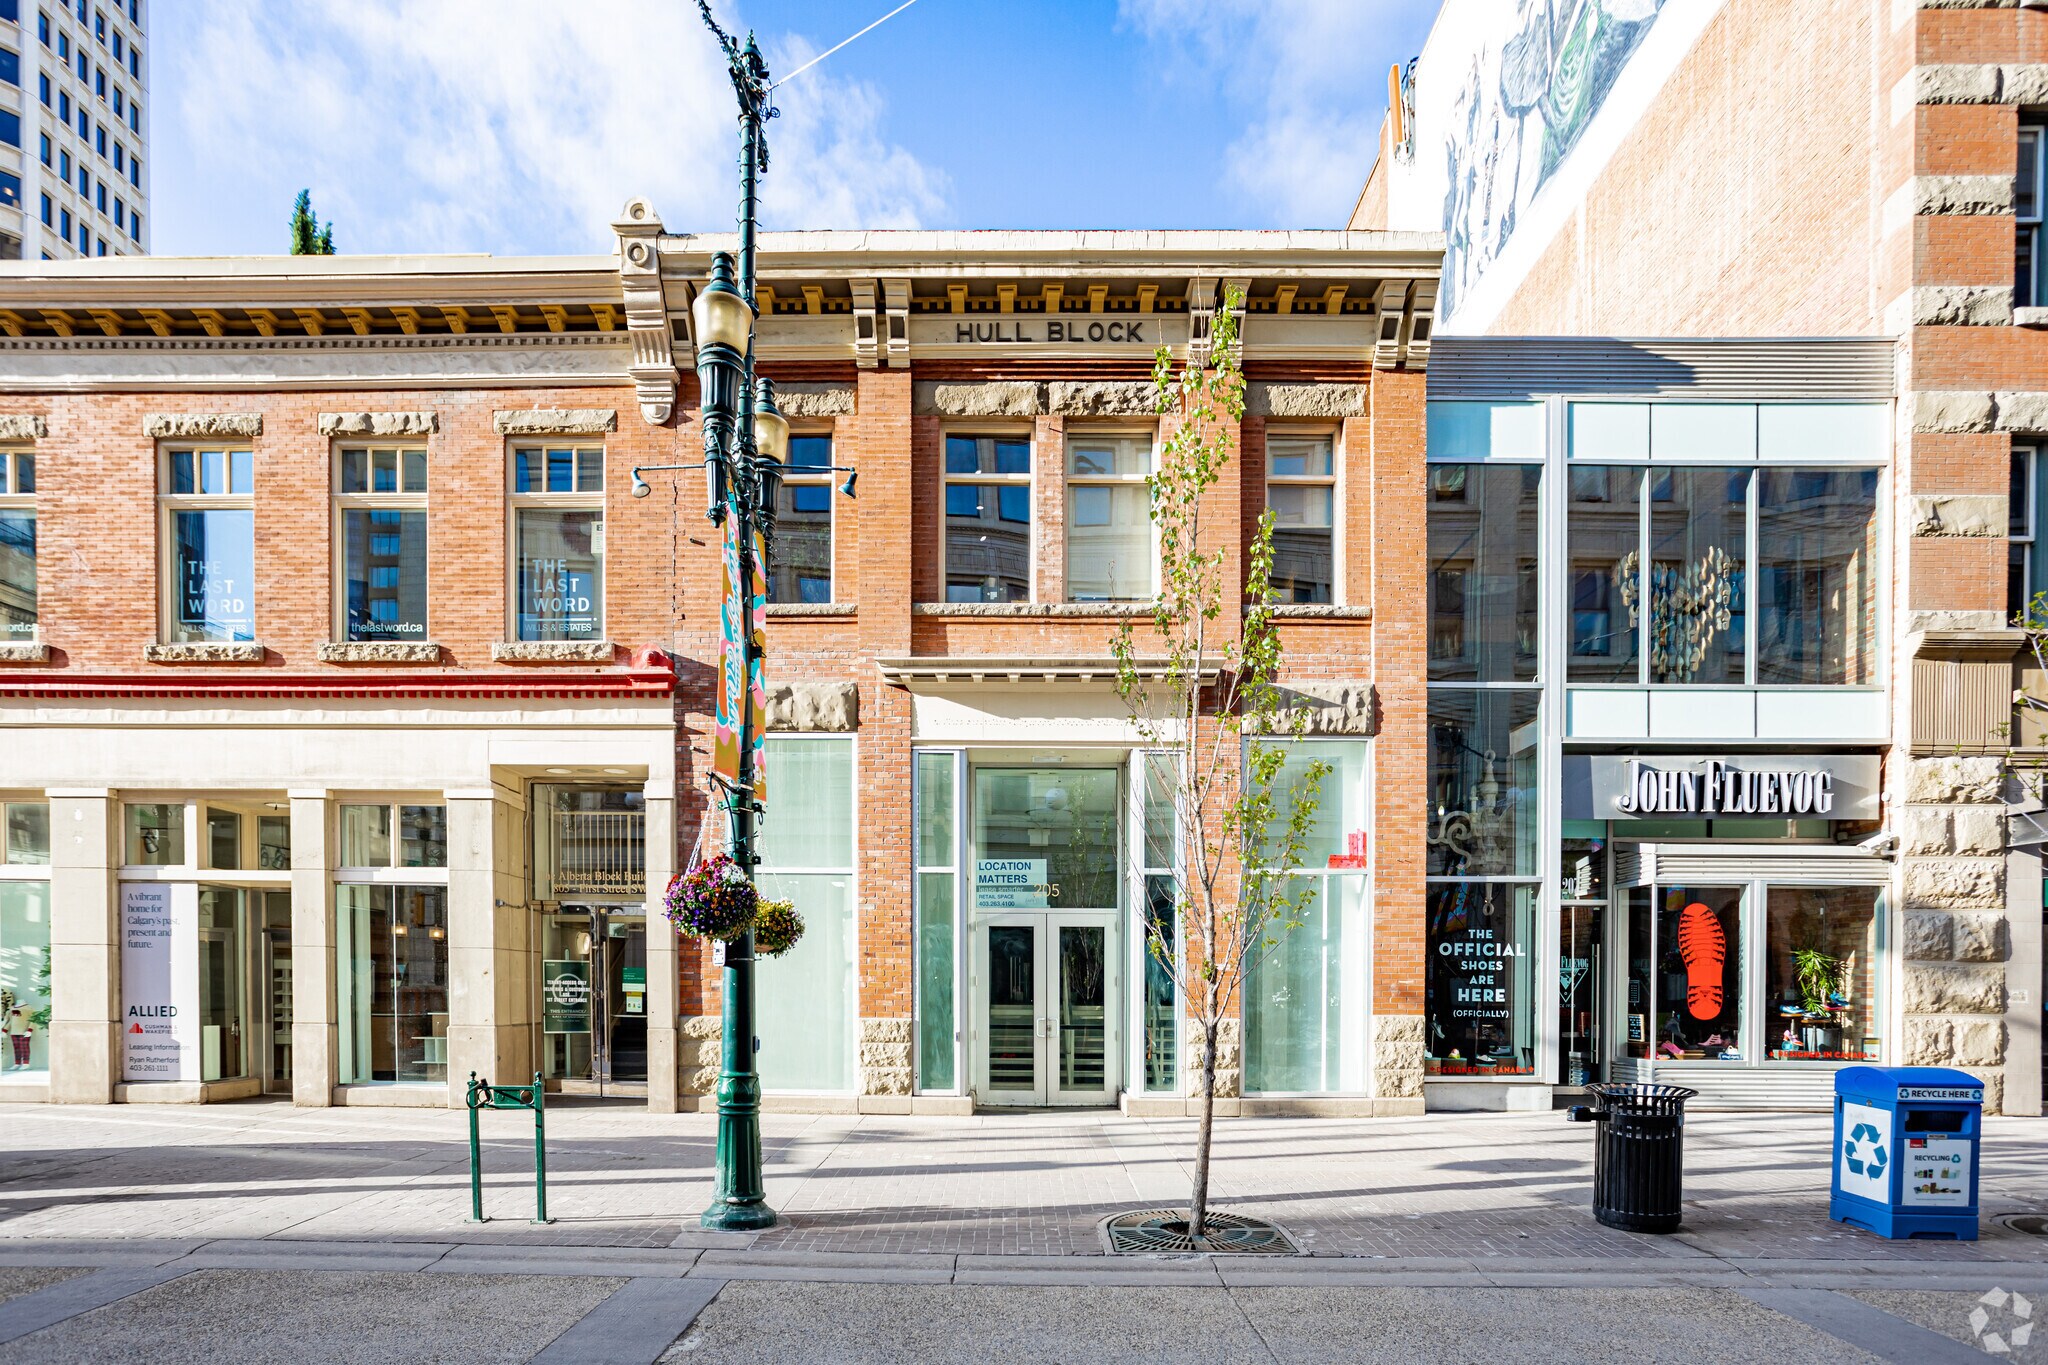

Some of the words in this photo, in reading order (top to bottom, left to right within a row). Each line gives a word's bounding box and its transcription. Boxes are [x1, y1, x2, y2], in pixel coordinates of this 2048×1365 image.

[957, 322, 1032, 343] HULL
[1047, 322, 1143, 343] BLOCK
[188, 561, 222, 575] THE
[532, 560, 567, 573] THE
[189, 580, 234, 594] LAST
[533, 578, 579, 592] LAST
[188, 599, 244, 614] WORD
[533, 598, 590, 612] WORD
[351, 622, 423, 632] thelastword.ca
[525, 624, 548, 632] WILLS
[551, 624, 556, 632] &
[559, 624, 592, 632] ESTATES
[1617, 759, 1697, 813] JOHN
[1700, 759, 1834, 813] FLUEVOG
[978, 861, 1032, 871] LOCATION
[559, 871, 592, 880] Alberta
[595, 871, 621, 880] Block
[978, 874, 1028, 884] MATTERS
[579, 884, 600, 893] First
[602, 884, 629, 893] Street
[1033, 884, 1060, 897] 205
[127, 893, 134, 901] A
[135, 892, 162, 901] vibrant
[127, 904, 150, 913] home
[151, 904, 163, 913] for
[127, 915, 162, 927] Calgary's
[127, 928, 156, 938] present
[157, 928, 172, 937] and
[1468, 929, 1493, 939] THE
[127, 939, 153, 949] future.
[1438, 942, 1526, 957] OFFICIAL
[1460, 960, 1503, 971] SHOES
[1469, 975, 1494, 985] ARE
[1457, 988, 1506, 1003] HERE
[128, 1005, 178, 1017] ALLIED
[1453, 1009, 1509, 1018] (OFFICIALLY)
[128, 1043, 153, 1051] Leasing
[1778, 1050, 1821, 1059] DESIGNED
[1823, 1050, 1833, 1059] IN
[128, 1056, 145, 1064] Ryan
[146, 1056, 180, 1064] Rutherford
[1436, 1066, 1479, 1074] DESIGNED
[1492, 1066, 1527, 1074] CANADA
[1911, 1090, 1947, 1098] RECYCLE
[1948, 1090, 1970, 1099] HERE
